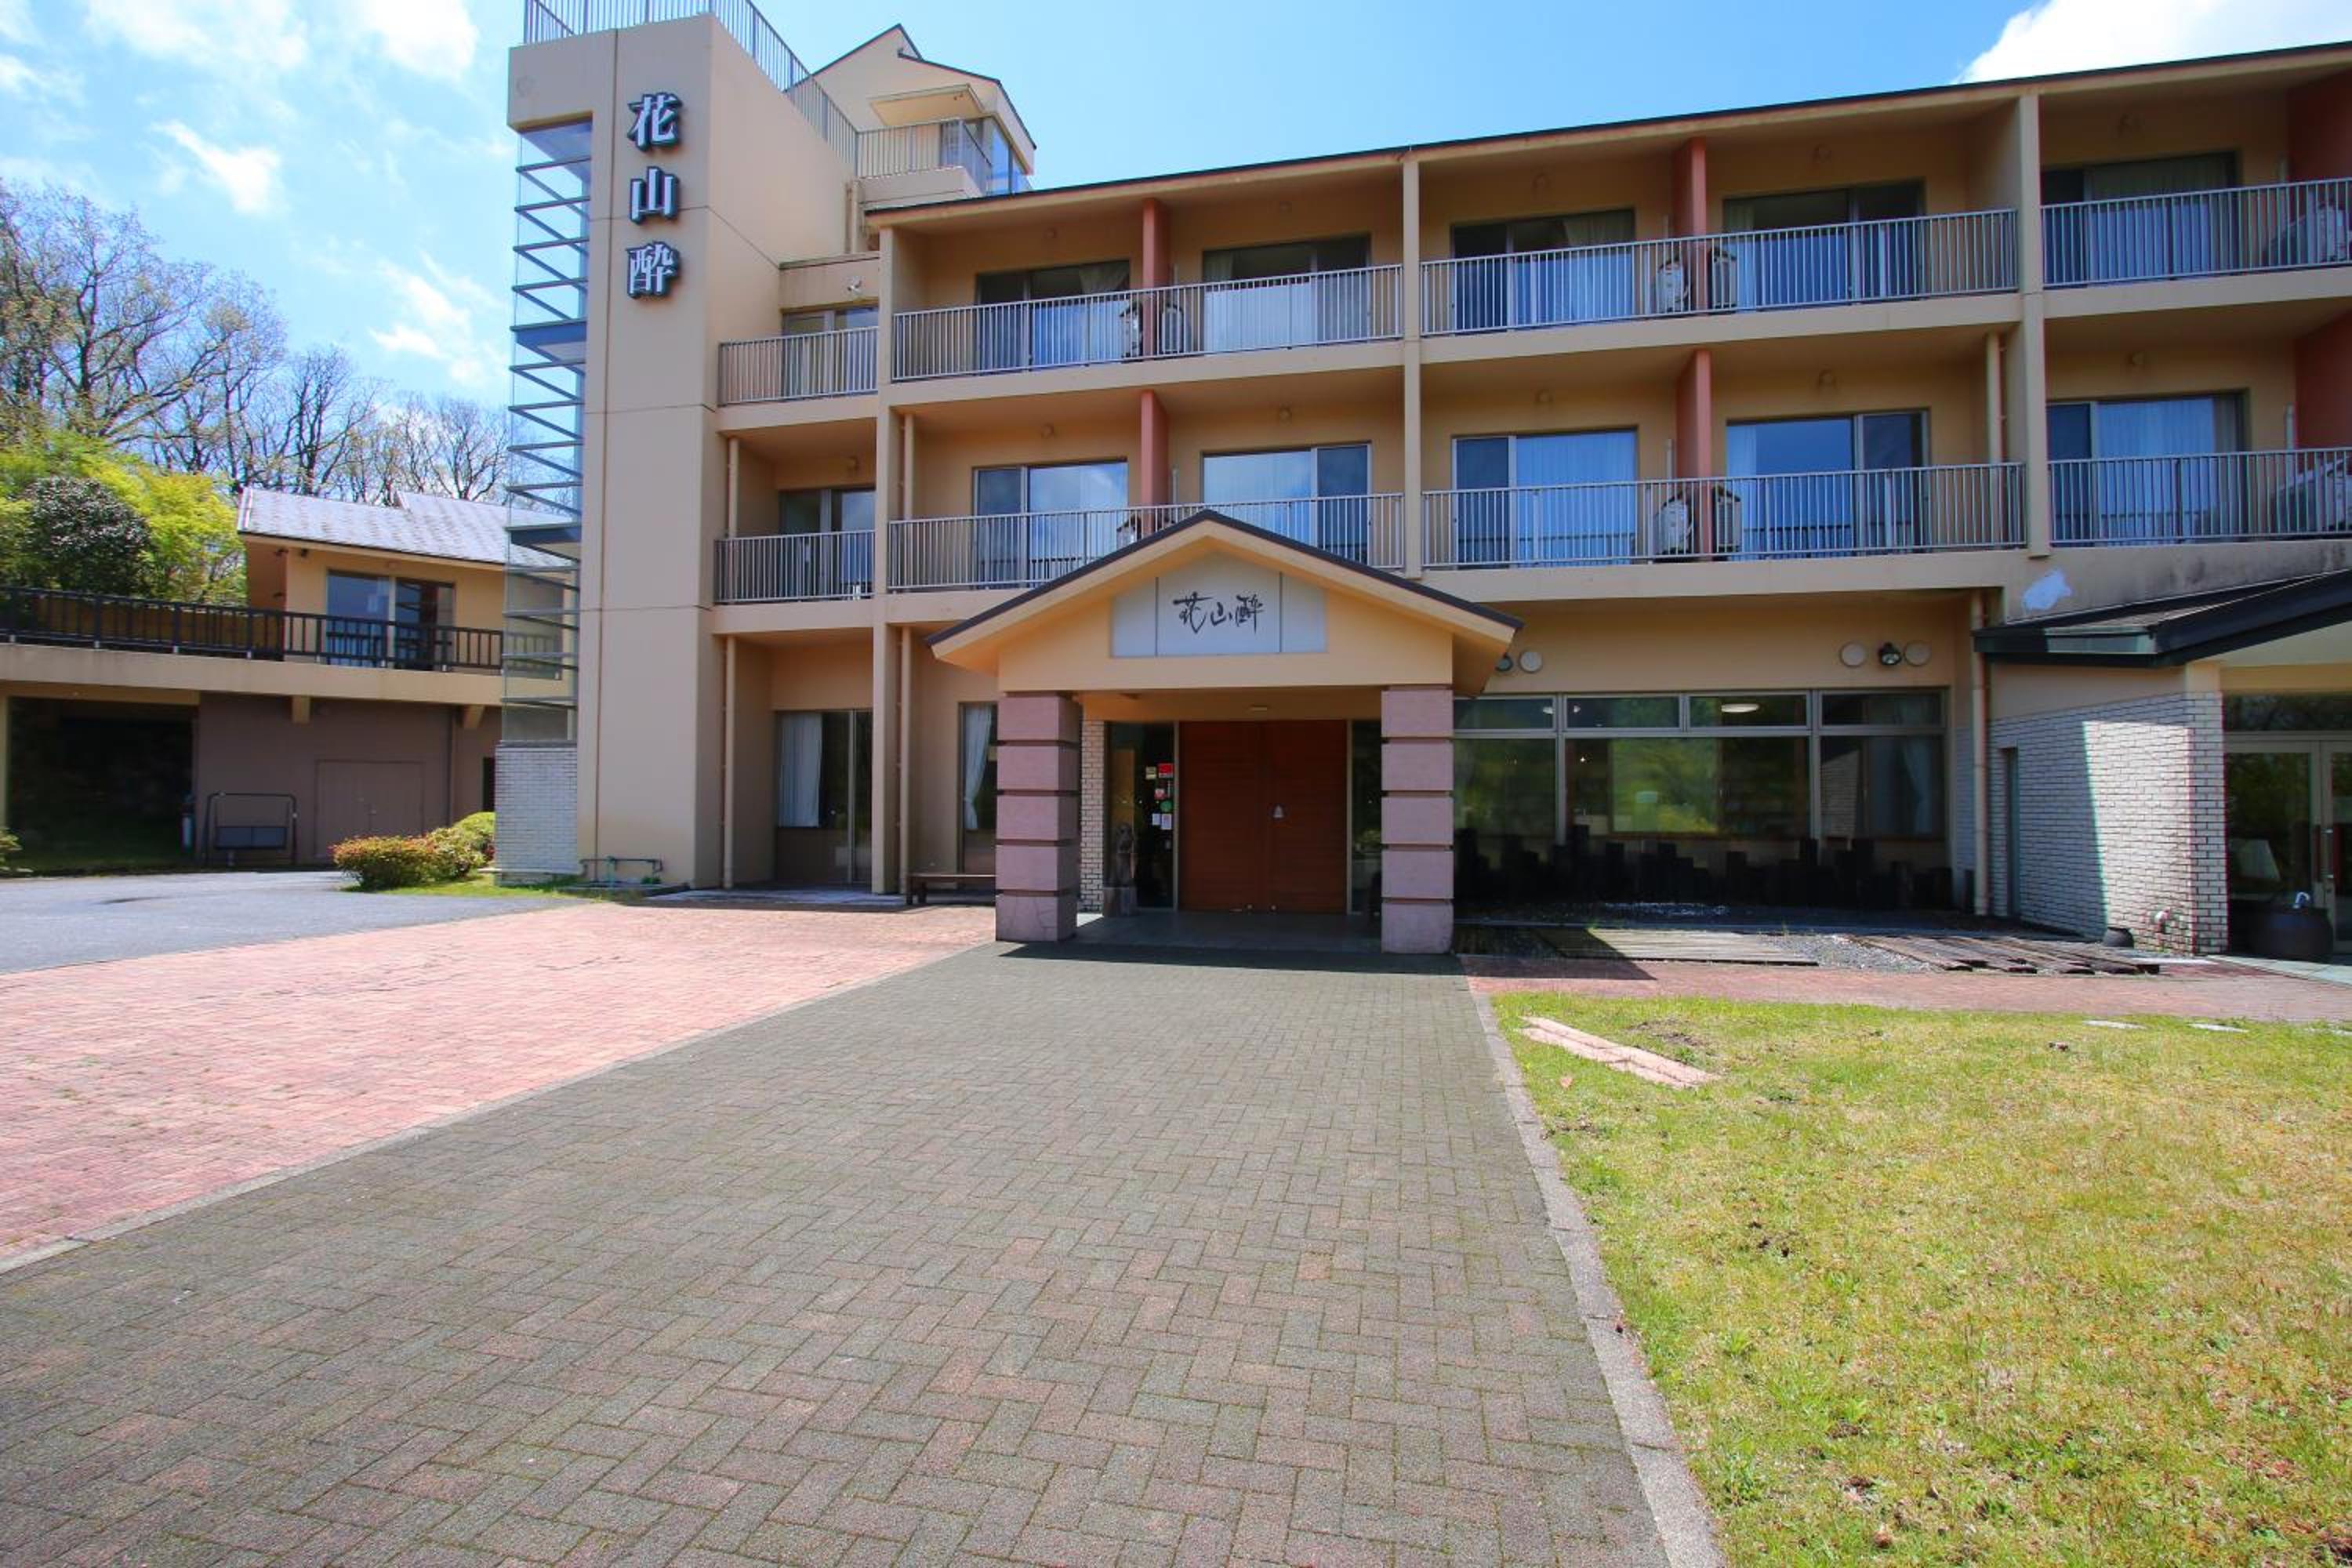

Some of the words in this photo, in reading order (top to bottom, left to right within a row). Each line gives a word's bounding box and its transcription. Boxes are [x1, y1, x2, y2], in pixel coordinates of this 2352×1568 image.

[626, 92, 681, 298] 花山酔
[1173, 592, 1264, 633] 花山酔
